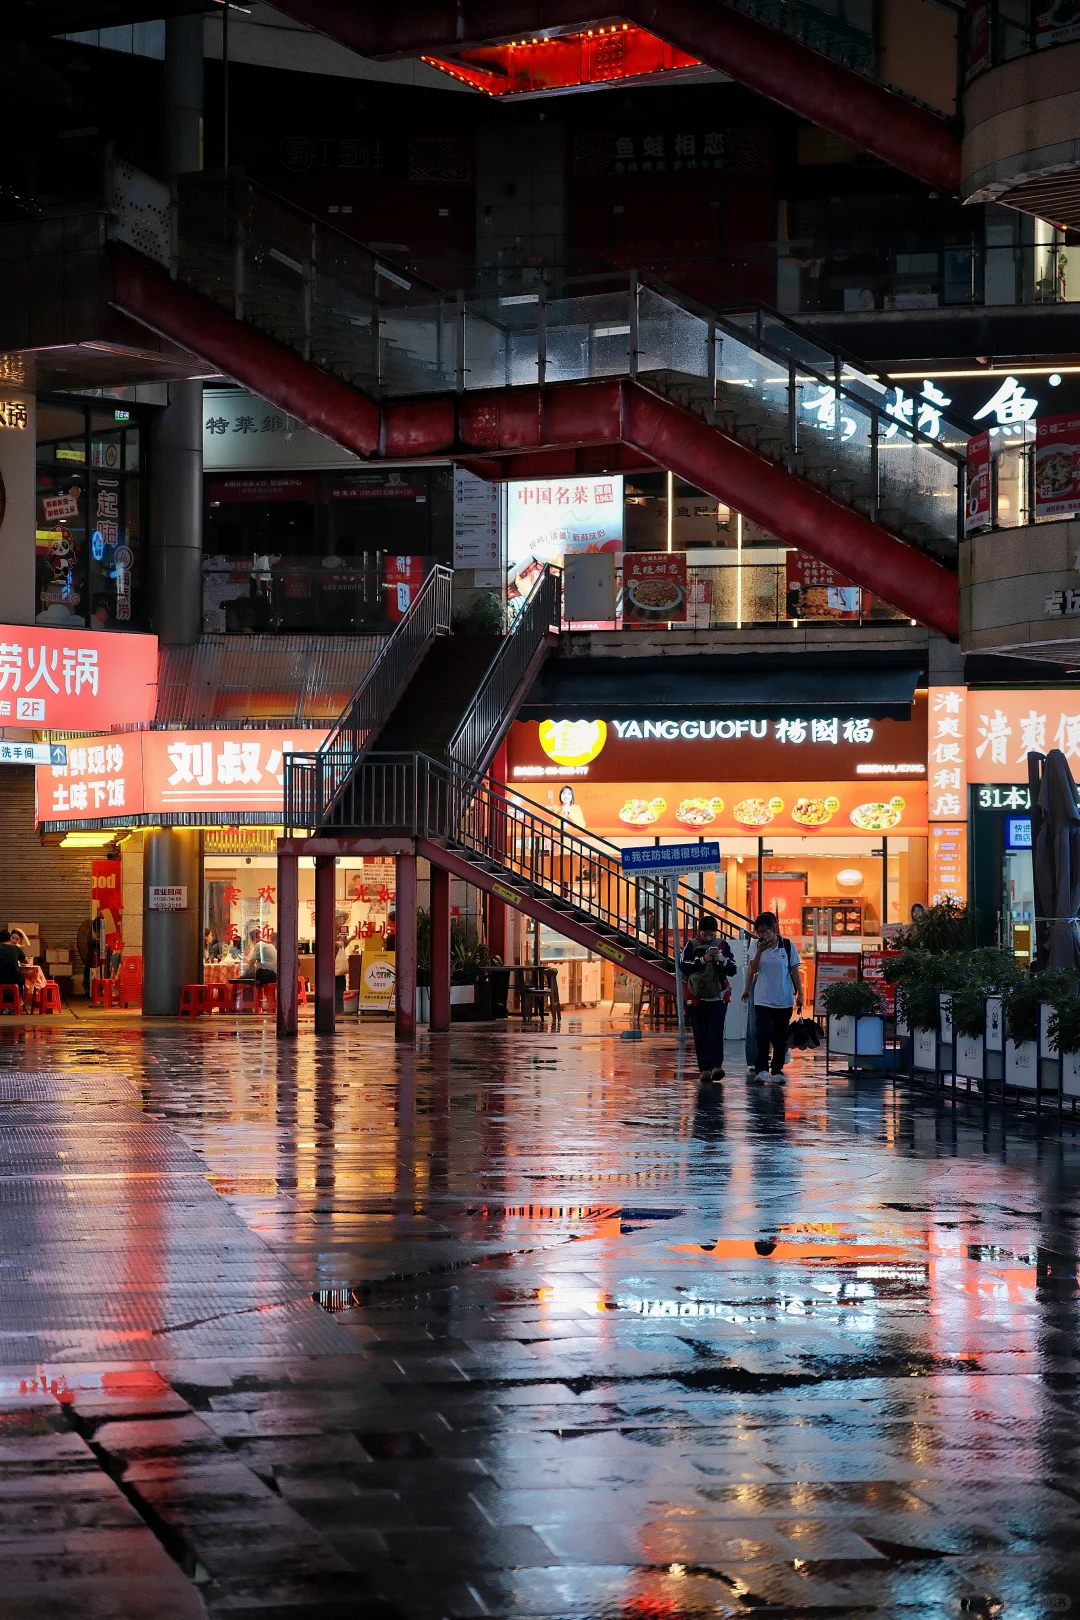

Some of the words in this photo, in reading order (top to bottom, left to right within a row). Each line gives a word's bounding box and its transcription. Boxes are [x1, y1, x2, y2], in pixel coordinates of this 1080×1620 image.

[615, 132, 728, 159] 鱼蛙相恋
[517, 486, 589, 505] 中国名菜
[1042, 484, 1050, 496] 2F
[595, 494, 613, 504] 1963
[97, 478, 118, 547] 一起嗨
[20, 701, 41, 717] 2F
[612, 719, 768, 740] YANGGUOFU
[774, 717, 875, 744] 楊國福
[2, 745, 34, 760] 洗手间
[932, 691, 964, 816] 清爽便利店
[52, 778, 126, 811] 土味下饭
[632, 847, 710, 862] 我在防城港很想你
[153, 888, 183, 896] 营业时间
